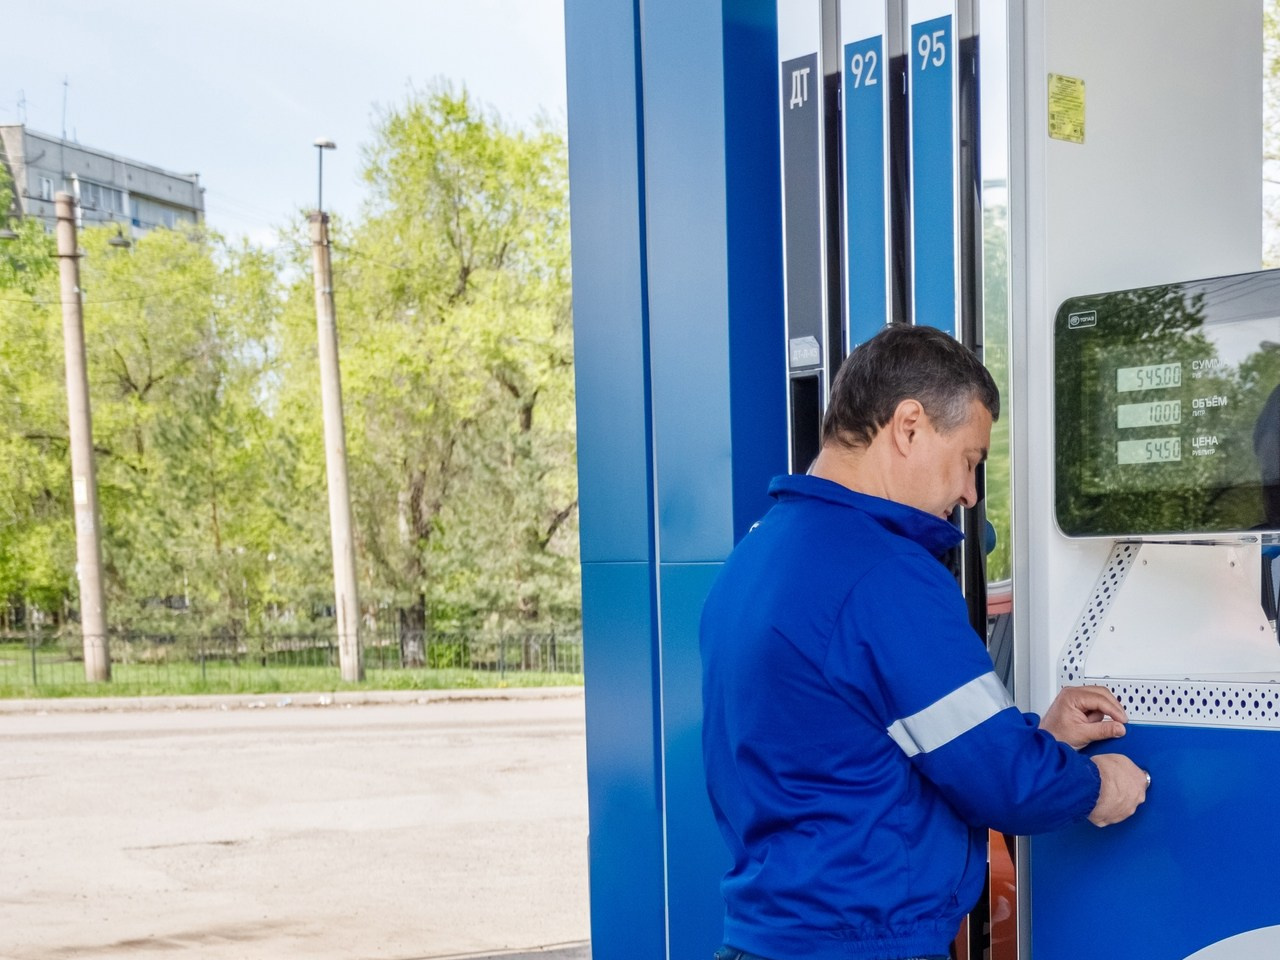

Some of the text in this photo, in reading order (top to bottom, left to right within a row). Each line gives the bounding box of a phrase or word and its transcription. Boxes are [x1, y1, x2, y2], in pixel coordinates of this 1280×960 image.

[851, 50, 878, 88] 92
[918, 30, 946, 70] 95
[790, 67, 810, 109] ДТ
[1192, 395, 1228, 409] ОБЪЁМ
[1192, 436, 1219, 448] ЦЕНА
